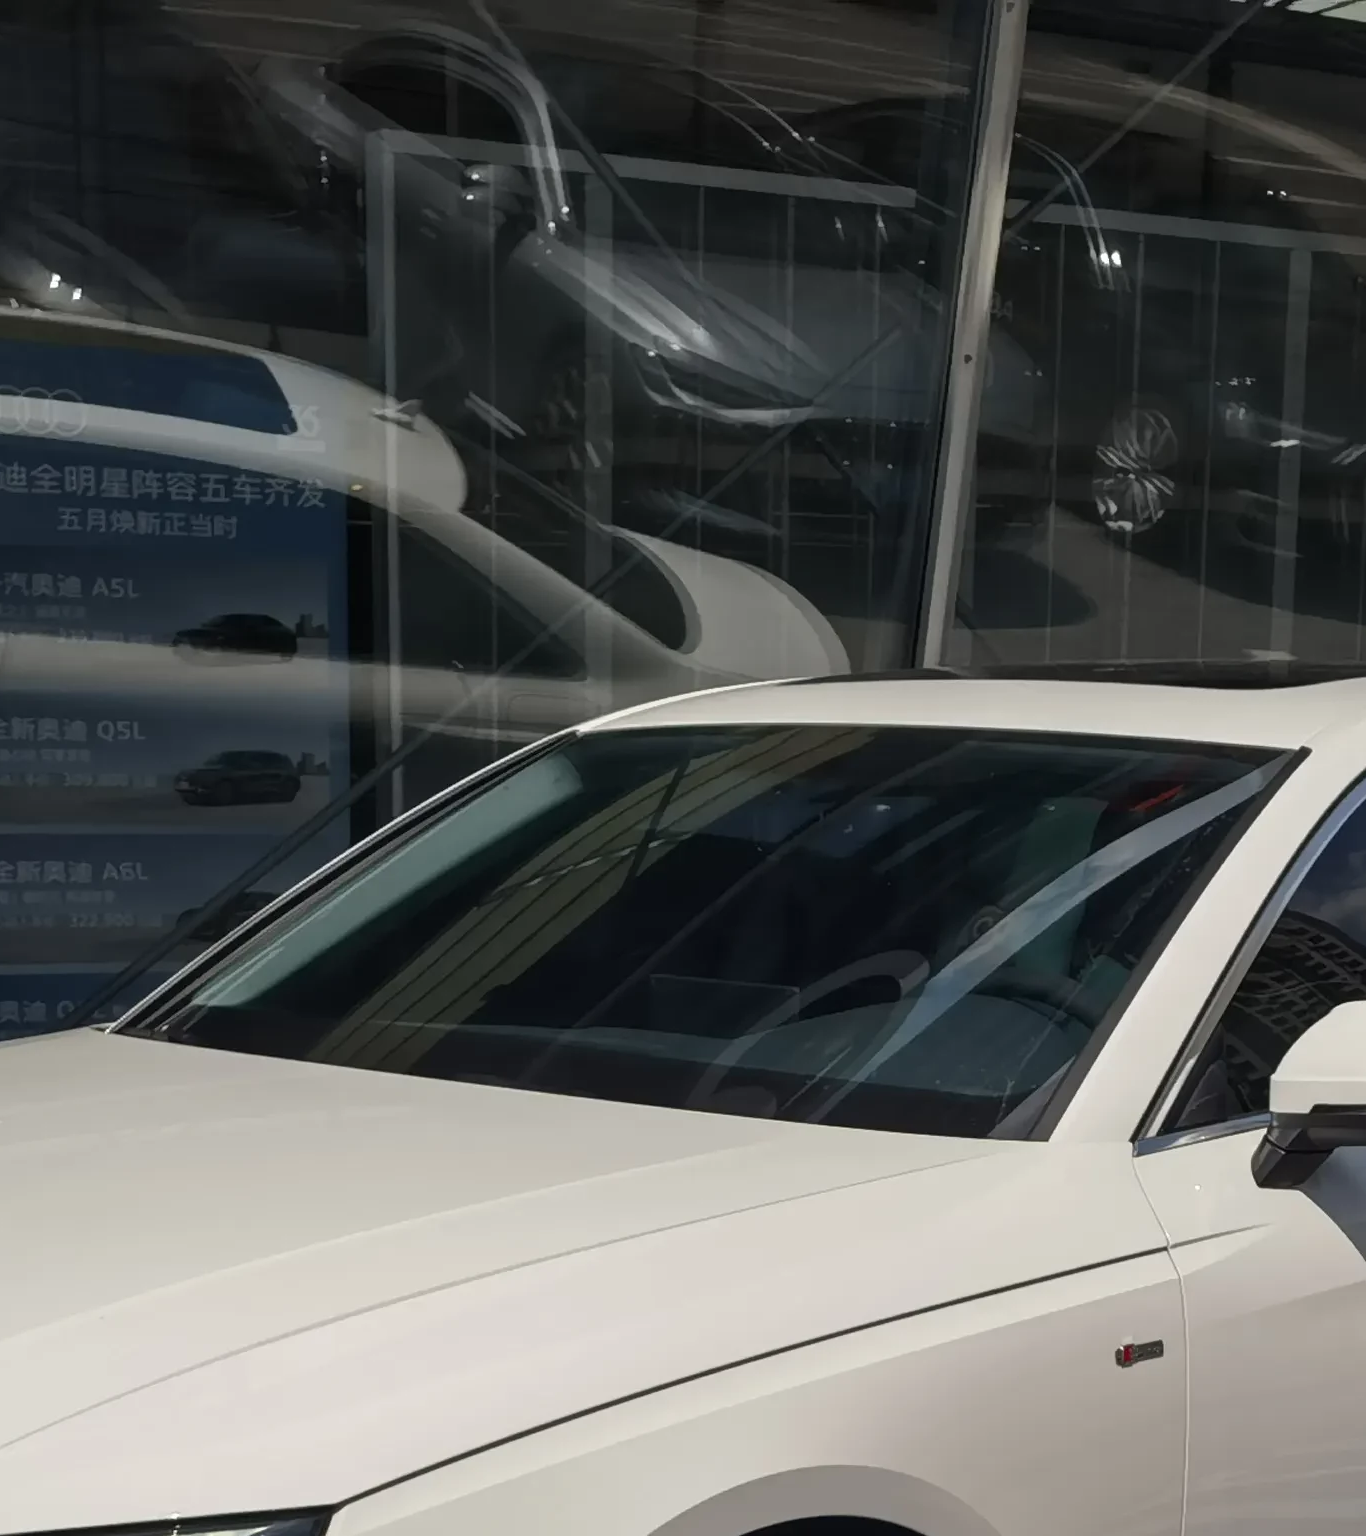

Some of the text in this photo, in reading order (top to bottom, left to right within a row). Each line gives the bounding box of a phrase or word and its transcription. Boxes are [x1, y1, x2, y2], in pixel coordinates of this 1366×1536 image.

[57, 507, 238, 539] 五月焕新正当时
[92, 577, 139, 598] A5L
[97, 720, 146, 742] Q5L
[102, 862, 149, 882] A6L
